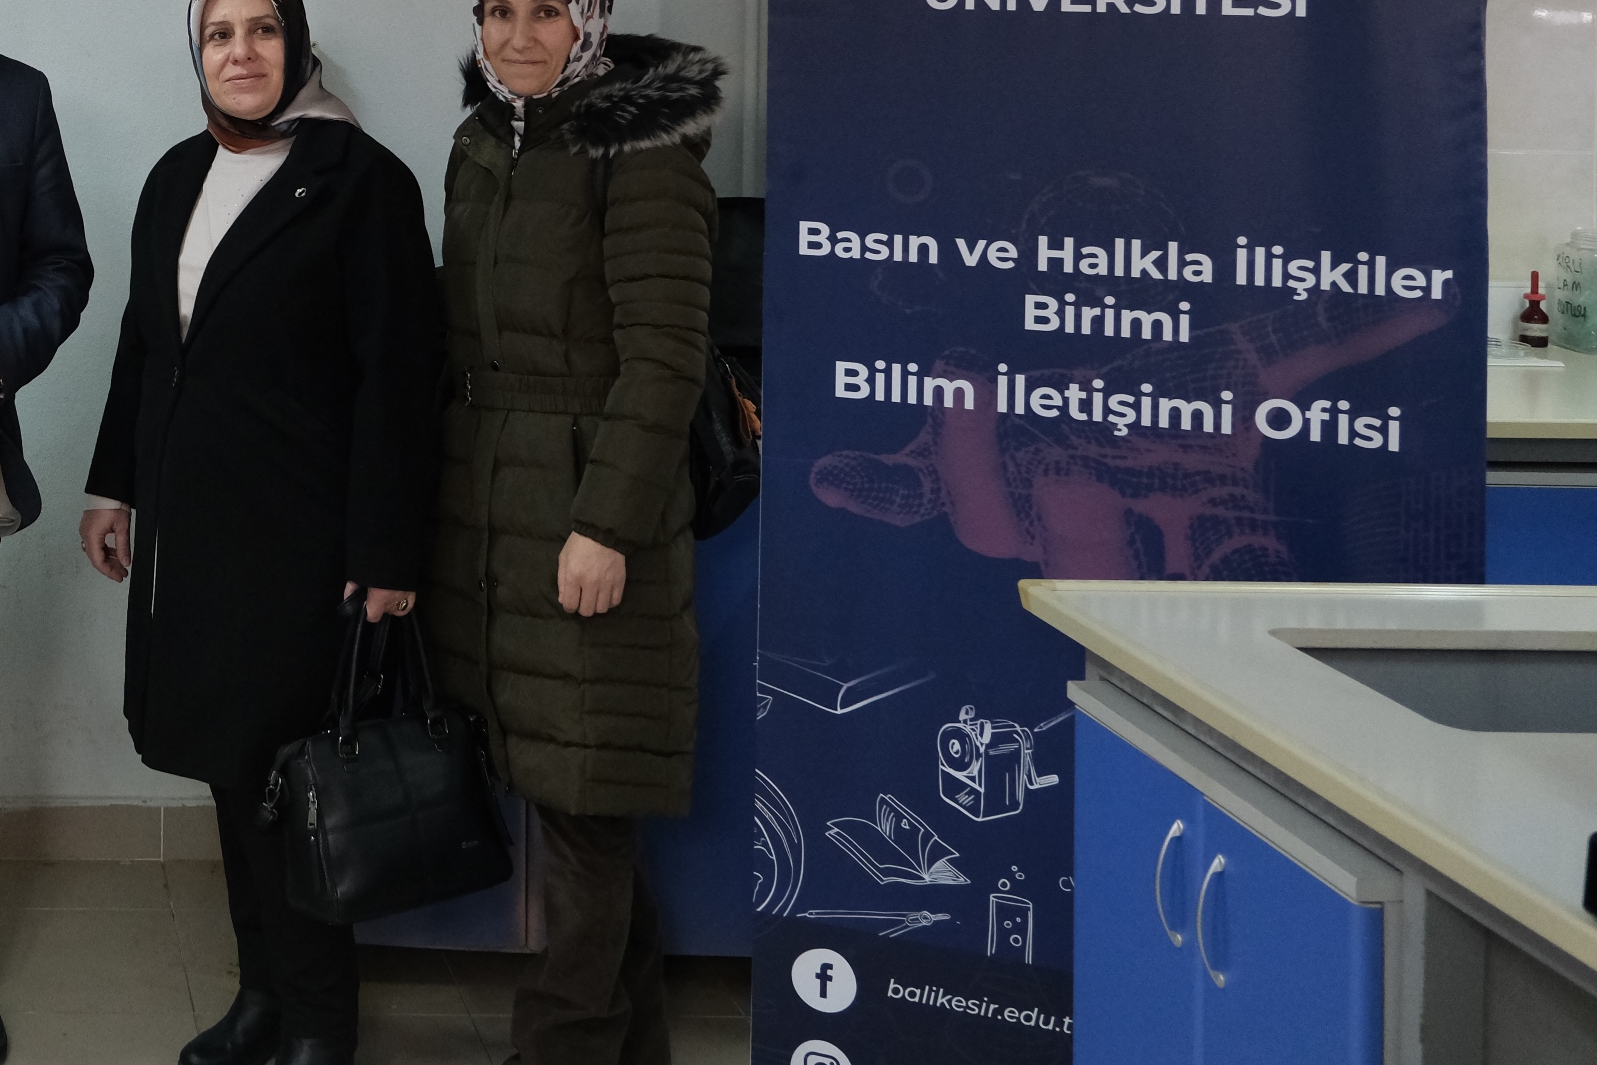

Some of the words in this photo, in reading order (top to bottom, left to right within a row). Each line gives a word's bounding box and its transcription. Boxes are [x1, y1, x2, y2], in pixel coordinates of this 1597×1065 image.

[797, 219, 939, 265] Basın
[955, 237, 1019, 270] ve
[1036, 235, 1214, 284] Halkla
[1235, 236, 1454, 301] İlişkiler
[1024, 292, 1191, 343] Birimi
[833, 359, 976, 411] Bilim
[996, 363, 1234, 437] İletişimi
[1254, 396, 1402, 453] Ofisi
[887, 978, 1074, 1034] balikesir.edu.t
